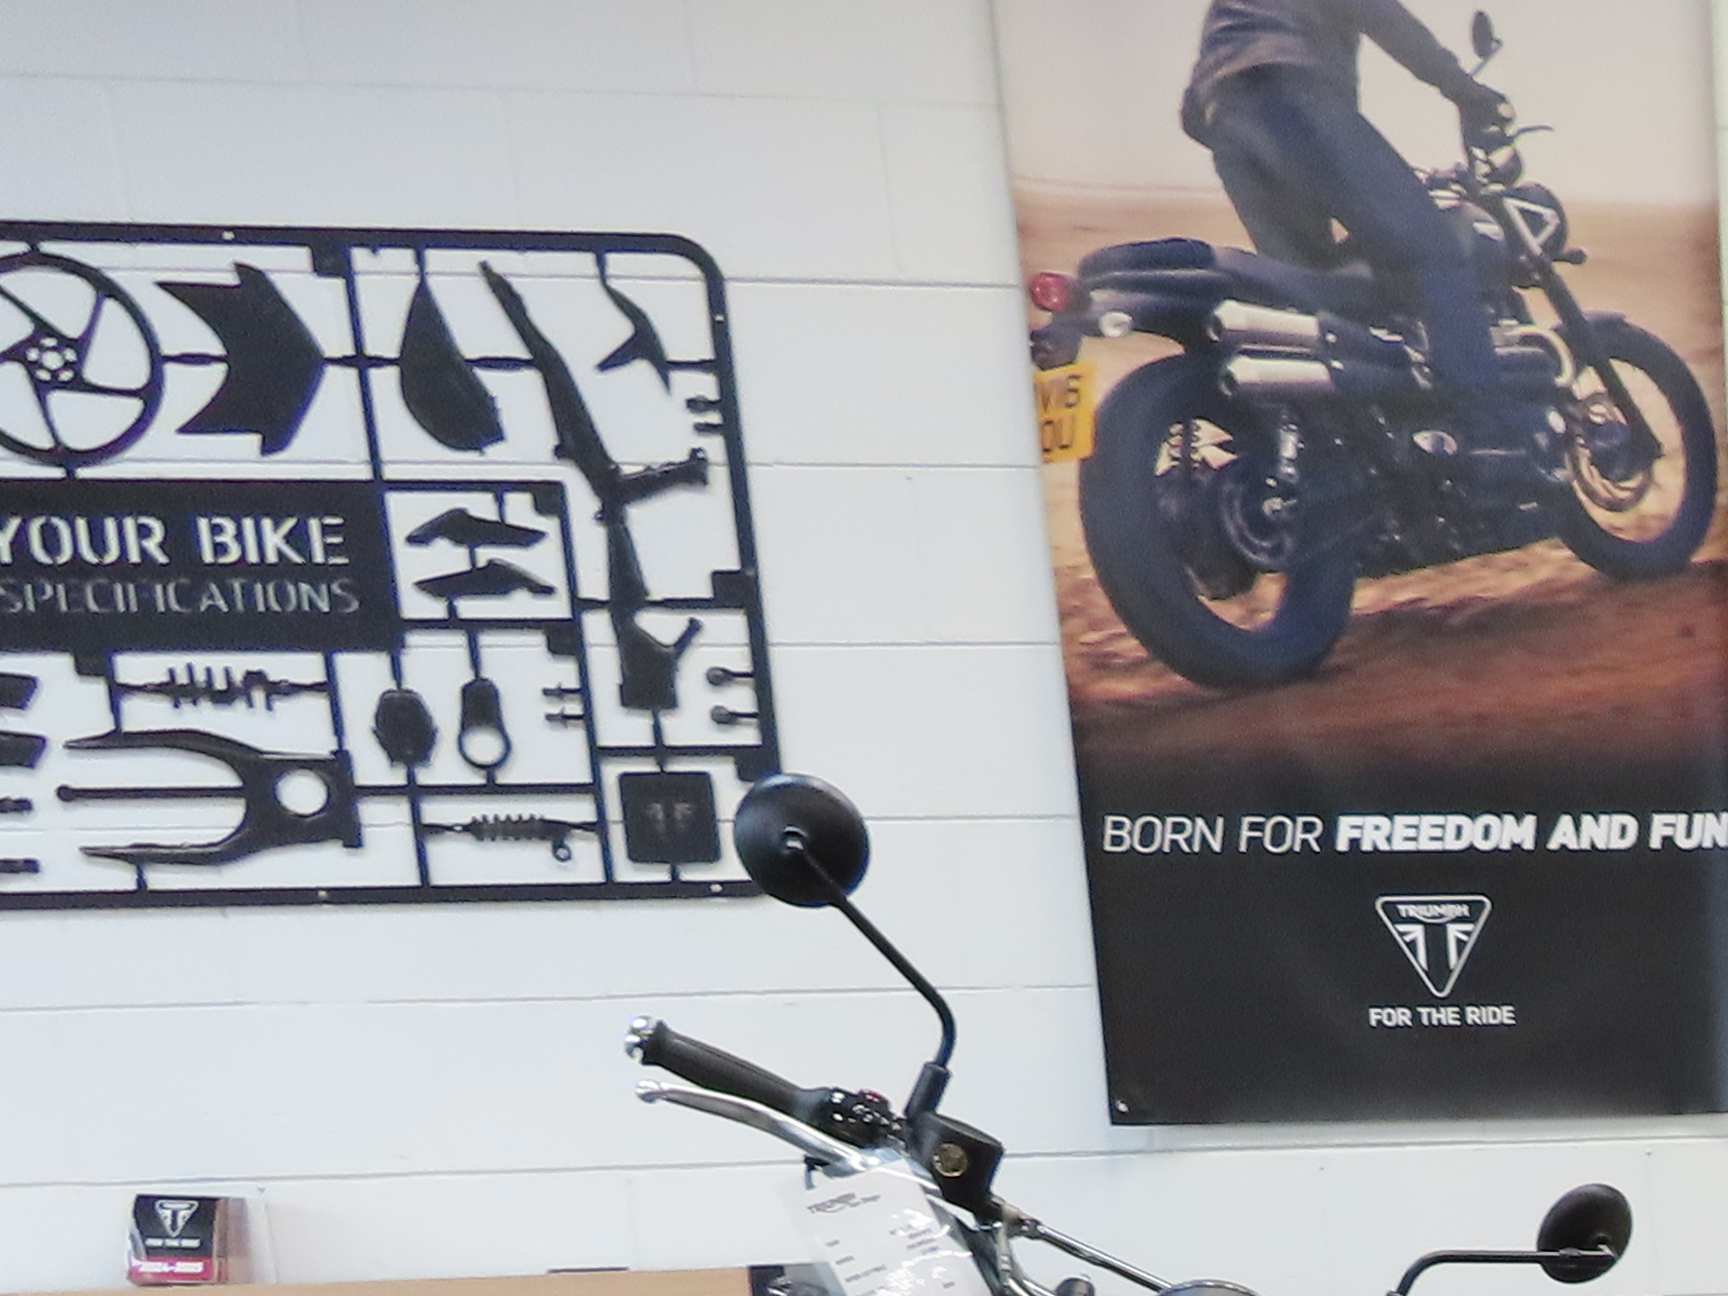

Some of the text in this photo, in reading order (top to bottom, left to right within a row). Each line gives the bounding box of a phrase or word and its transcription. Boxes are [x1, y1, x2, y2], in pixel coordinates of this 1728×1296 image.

[0, 515, 350, 565] YOUR BIKE
[0, 577, 360, 614] SPECIFICATIONS
[1102, 815, 1224, 853] BORN
[1238, 815, 1323, 853] FOR
[1334, 813, 1538, 853] FREEDOM
[1546, 812, 1639, 850] AND
[1368, 1005, 1516, 1027] FOR THE RIDE
